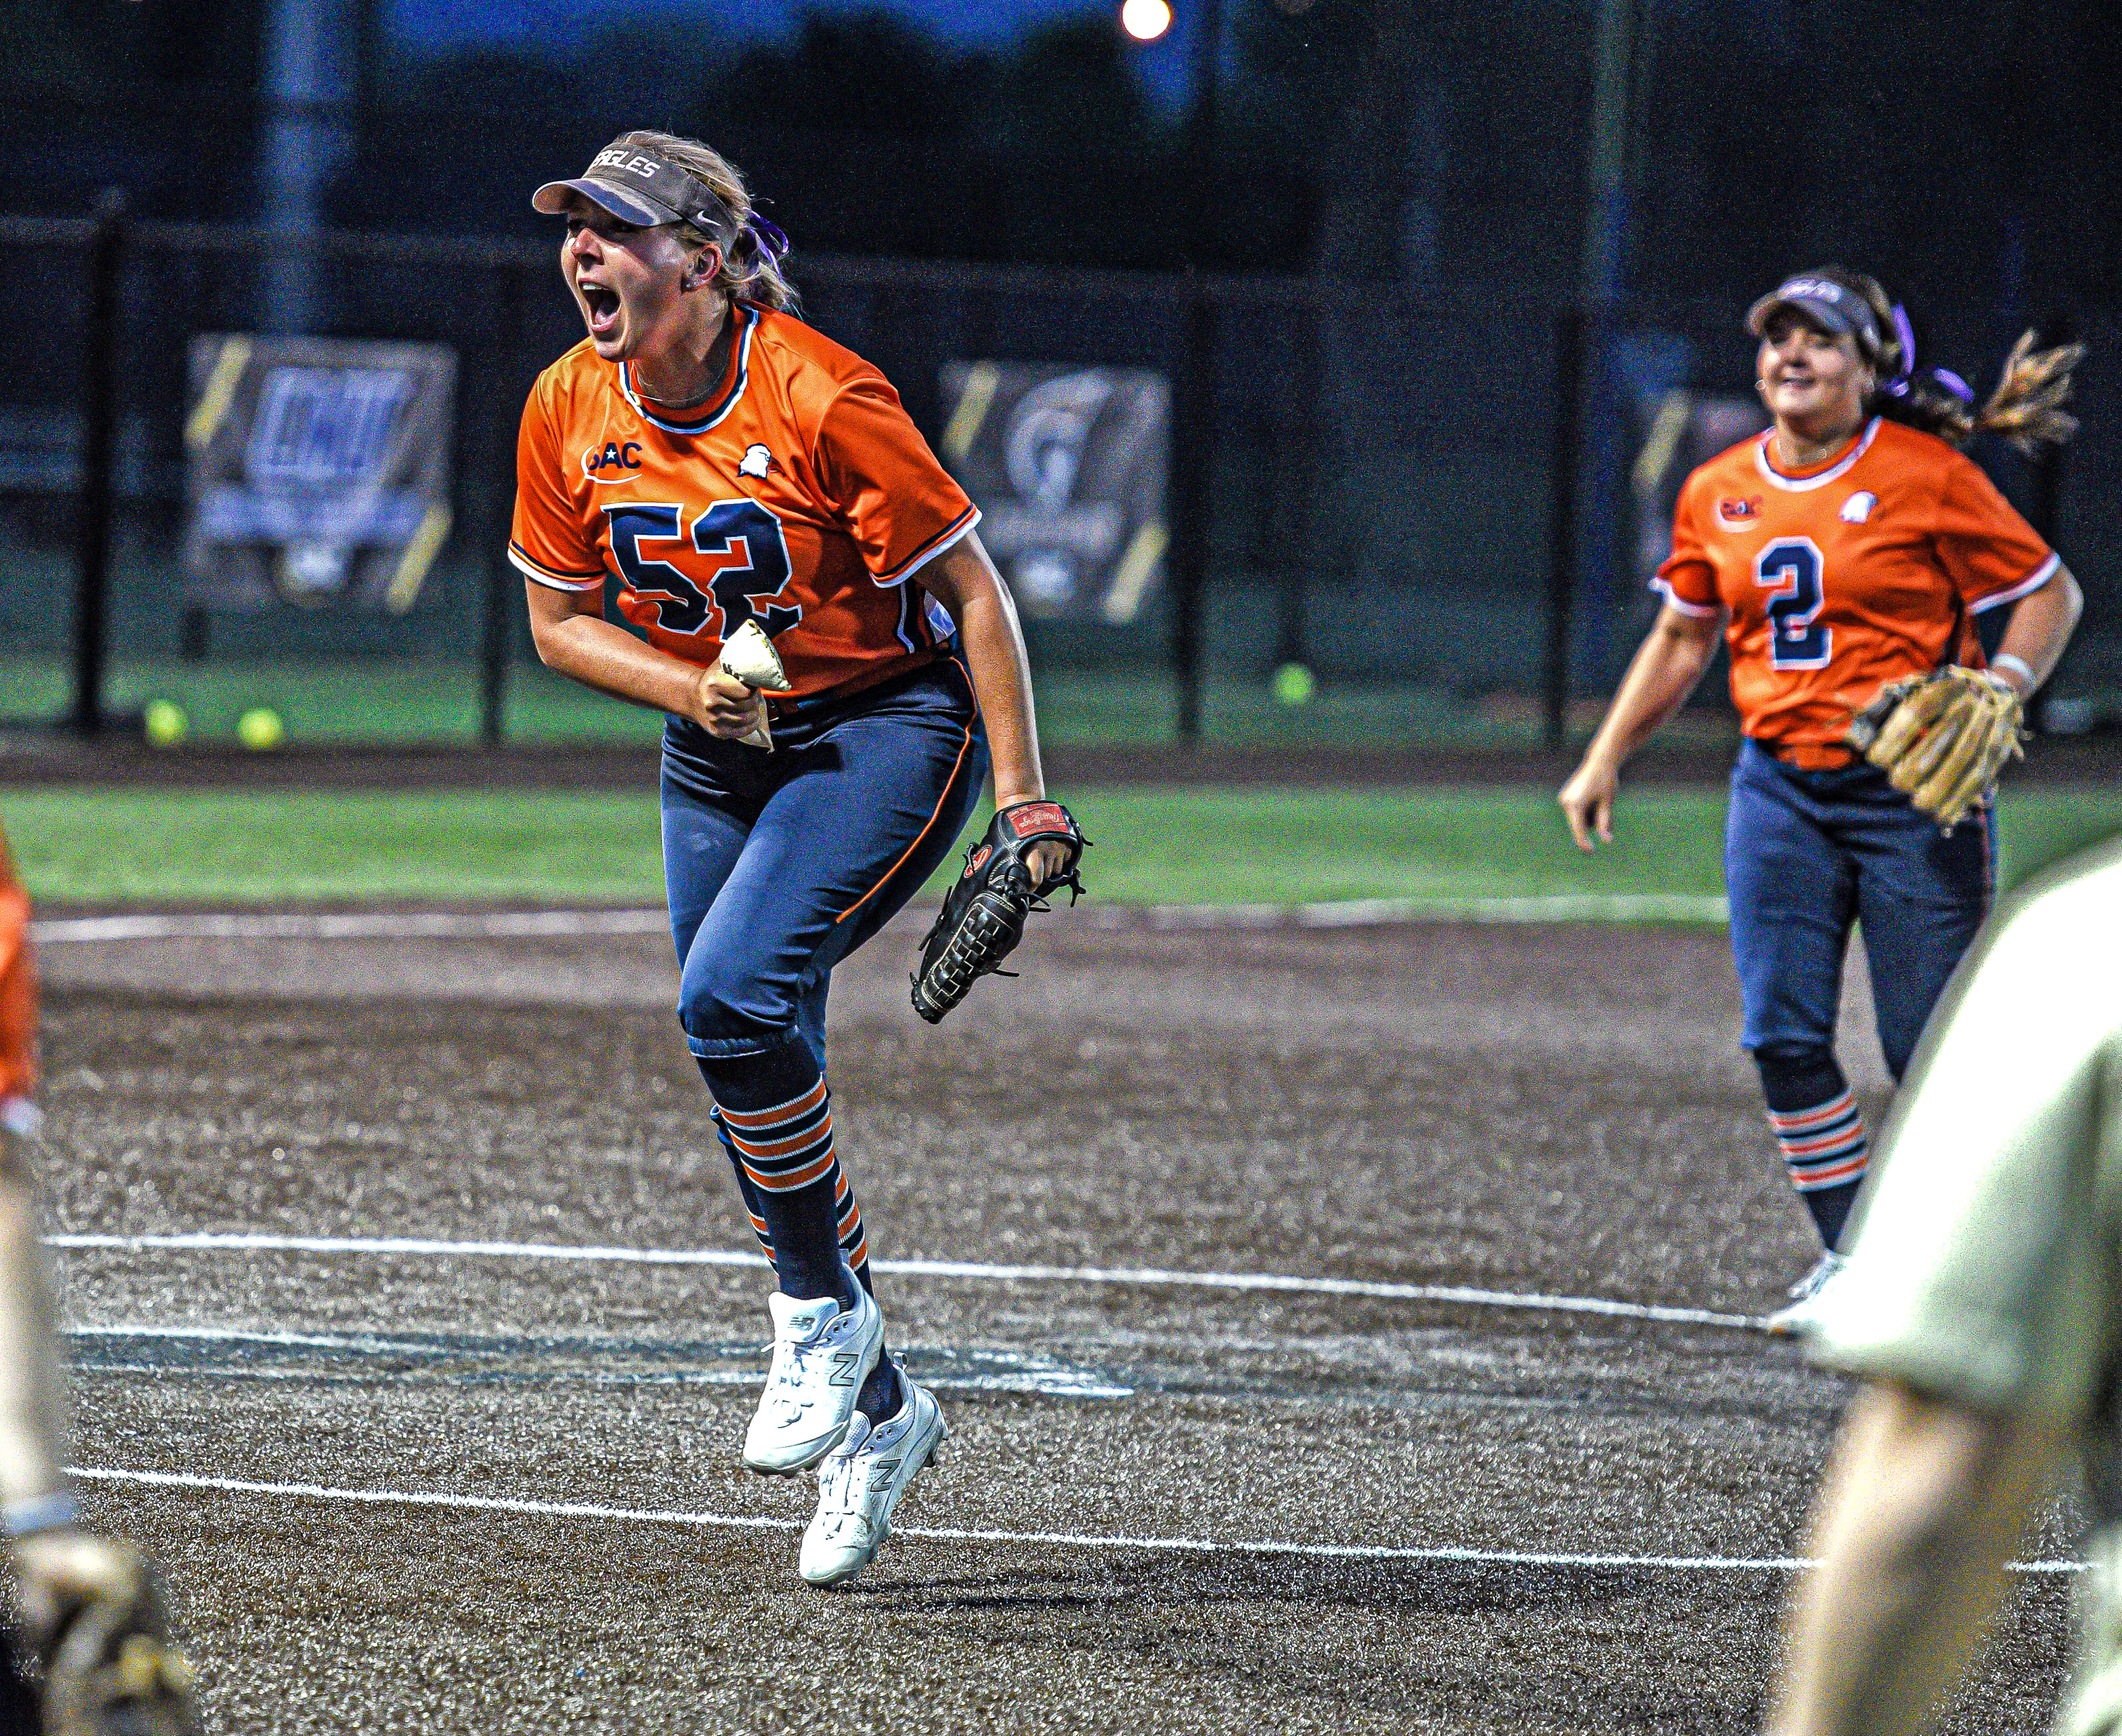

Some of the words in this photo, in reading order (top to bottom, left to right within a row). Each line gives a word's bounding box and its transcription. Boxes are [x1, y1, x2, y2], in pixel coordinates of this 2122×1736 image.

[600, 498, 803, 643] 52
[1752, 535, 1834, 672] 2
[829, 1353, 859, 1387] N
[869, 1458, 902, 1493] N
